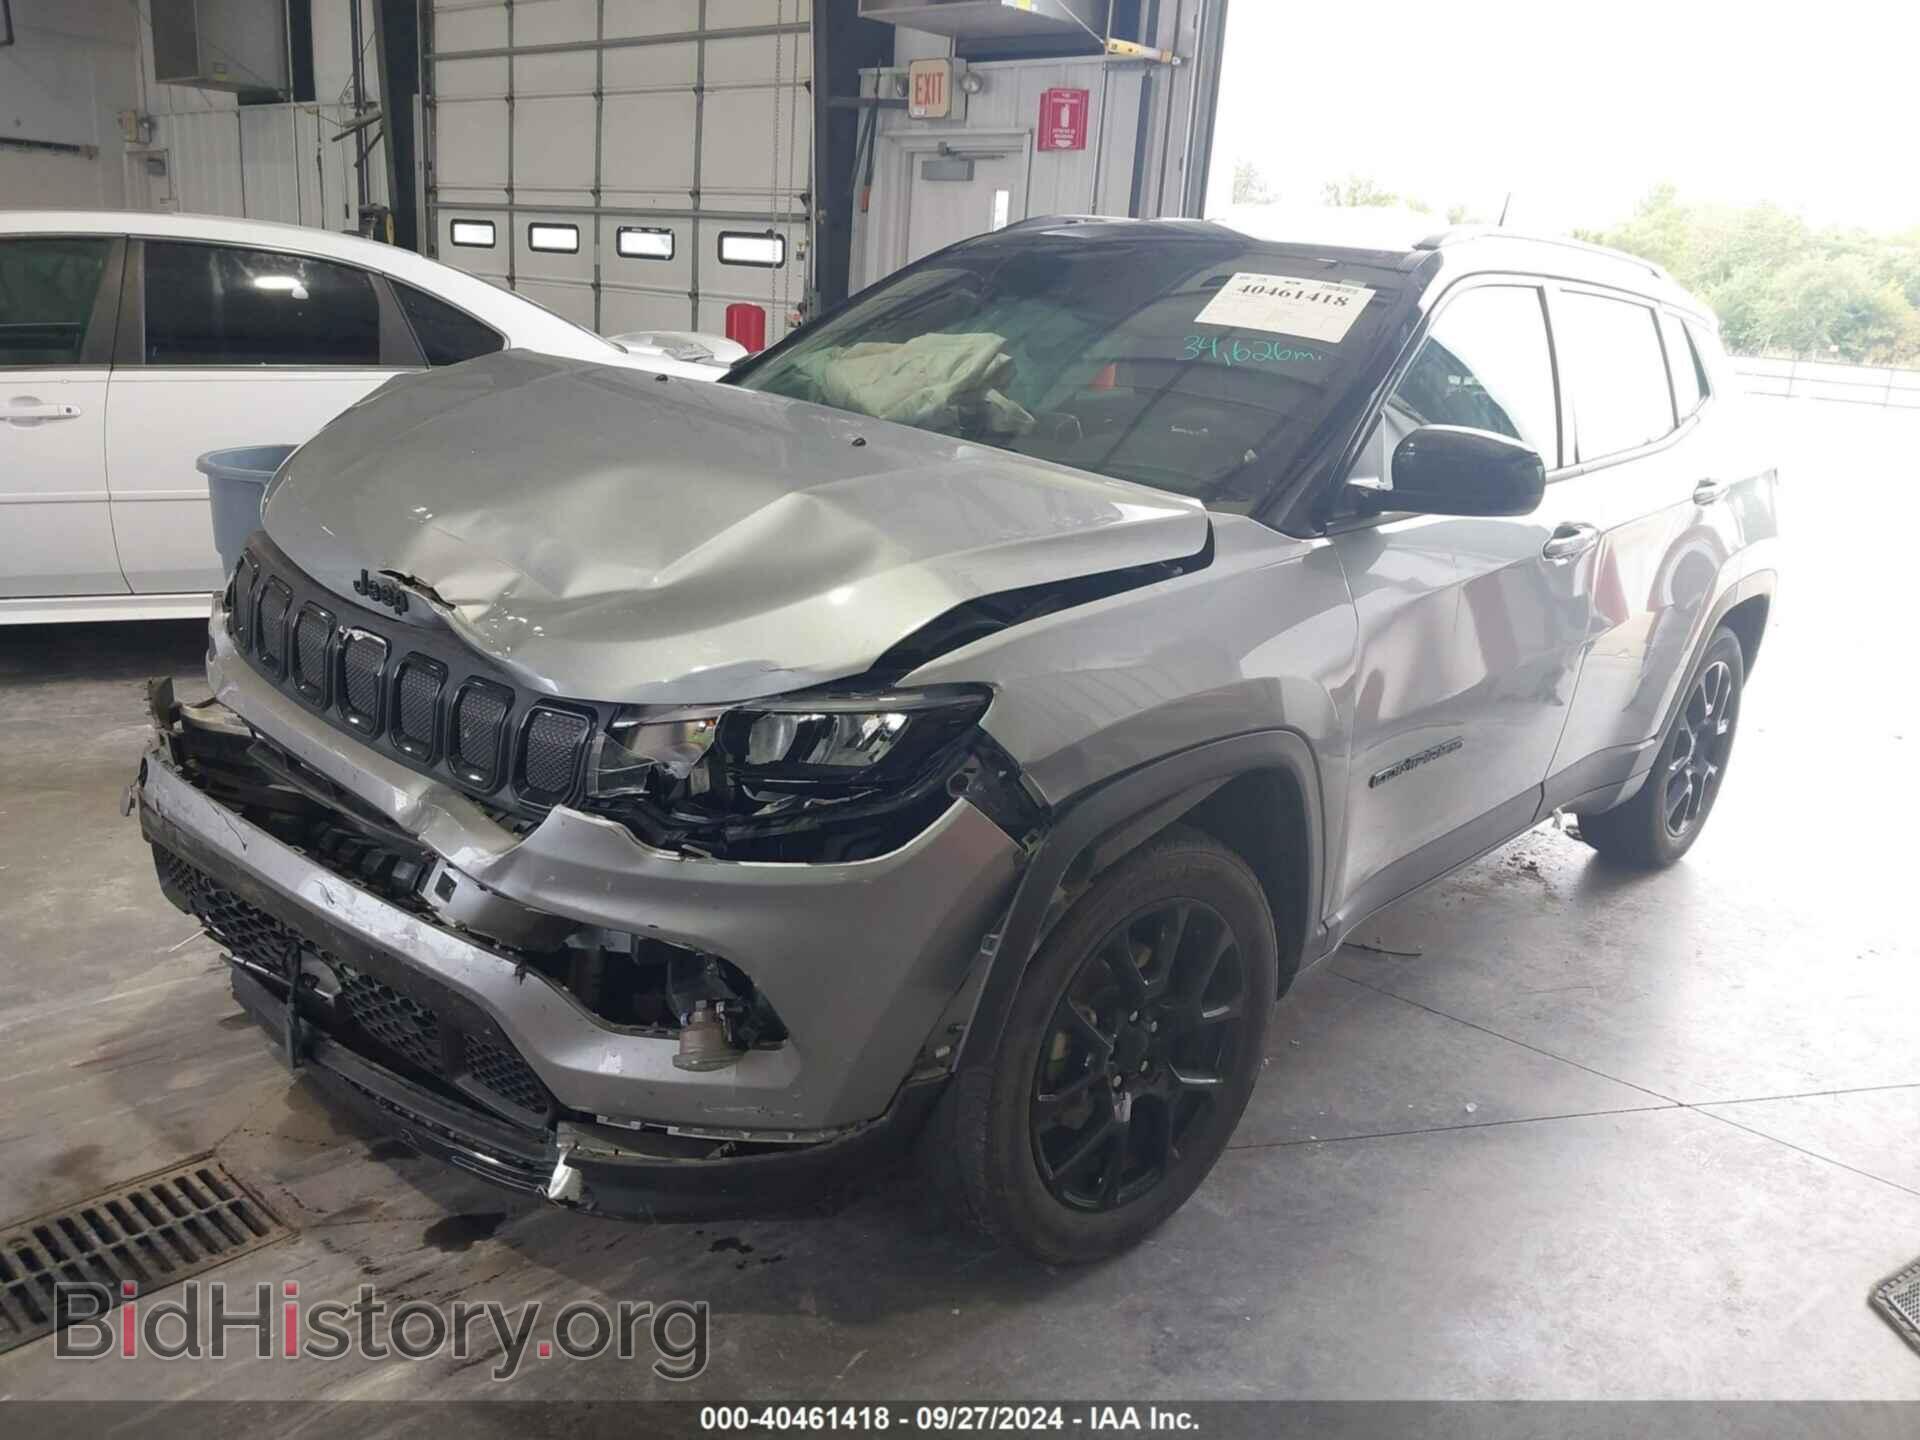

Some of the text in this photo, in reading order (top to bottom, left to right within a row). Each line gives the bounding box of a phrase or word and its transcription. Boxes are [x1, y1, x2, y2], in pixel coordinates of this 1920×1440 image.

[915, 72, 944, 105] EXIT
[1238, 284, 1349, 306] 40461418
[353, 569, 409, 616] Jeep
